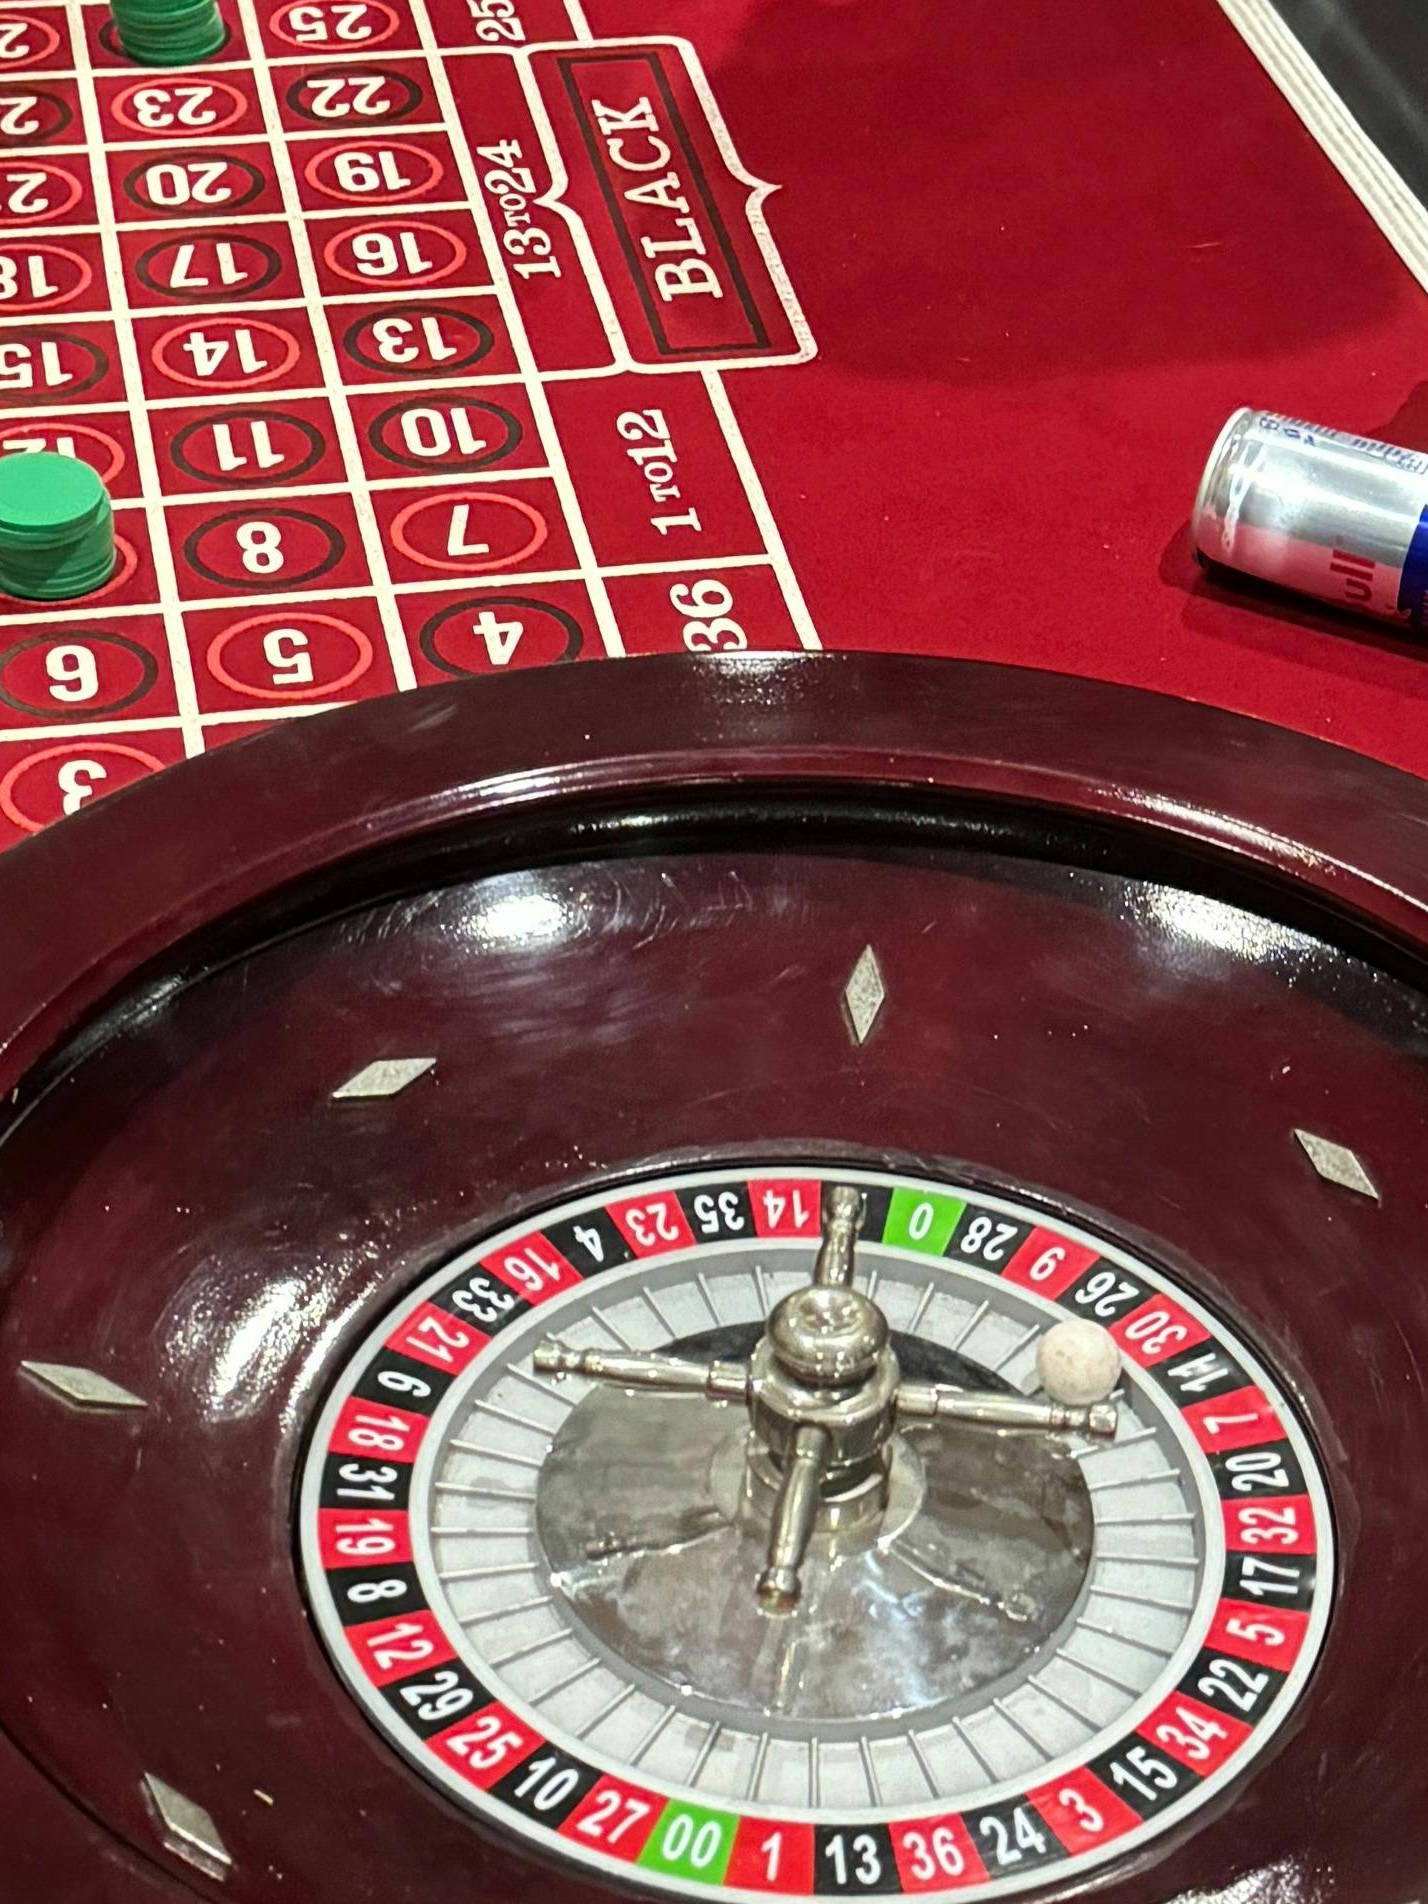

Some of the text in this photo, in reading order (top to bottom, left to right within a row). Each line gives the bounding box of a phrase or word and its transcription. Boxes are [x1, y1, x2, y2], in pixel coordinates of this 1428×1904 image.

[288, 3, 372, 44] 25
[133, 86, 217, 128] 23
[306, 75, 391, 118] 22
[145, 161, 232, 206] 20
[333, 150, 411, 192] 19
[591, 96, 724, 303] BLACK
[169, 242, 248, 289] 17
[352, 231, 433, 276] 16
[182, 328, 268, 378] 14
[372, 316, 457, 363] 13
[212, 420, 285, 471] 11
[400, 407, 487, 457] 10
[236, 521, 284, 574] 8
[447, 504, 490, 556] 7
[1329, 549, 1376, 607] ull
[263, 628, 314, 685] 5
[472, 611, 524, 666] 4
[45, 644, 99, 702] 6
[57, 759, 107, 816] 3
[625, 1202, 680, 1248] 23
[693, 1191, 745, 1230] 35
[763, 1189, 809, 1228] 14
[908, 1202, 934, 1240] 0
[573, 1225, 604, 1262] 4
[958, 1214, 1020, 1262] 28
[502, 1246, 562, 1294] 16
[1072, 1270, 1140, 1318] 26
[450, 1276, 517, 1324] 33
[404, 1314, 472, 1366] 21
[1122, 1308, 1188, 1356] 30
[1167, 1352, 1230, 1392] 11
[348, 1415, 410, 1451] 18
[1203, 1413, 1258, 1434] 7
[336, 1463, 398, 1501] 31
[1225, 1451, 1290, 1492] 20
[335, 1518, 395, 1555] 19
[1238, 1507, 1299, 1545] 32
[347, 1579, 407, 1603] 8
[1239, 1556, 1301, 1596] 17
[367, 1623, 434, 1669] 12
[1226, 1618, 1285, 1646] 5
[397, 1668, 476, 1722] 29
[1197, 1659, 1270, 1712] 22
[444, 1714, 524, 1772] 25
[1154, 1704, 1228, 1762] 34
[510, 1754, 582, 1812] 10
[1110, 1746, 1179, 1802] 15
[576, 1788, 652, 1846] 27
[1059, 1788, 1104, 1832] 3
[662, 1810, 722, 1868] 00
[762, 1832, 781, 1881] 1
[825, 1834, 881, 1885] 13
[903, 1827, 965, 1881] 36
[978, 1804, 1046, 1868] 24
